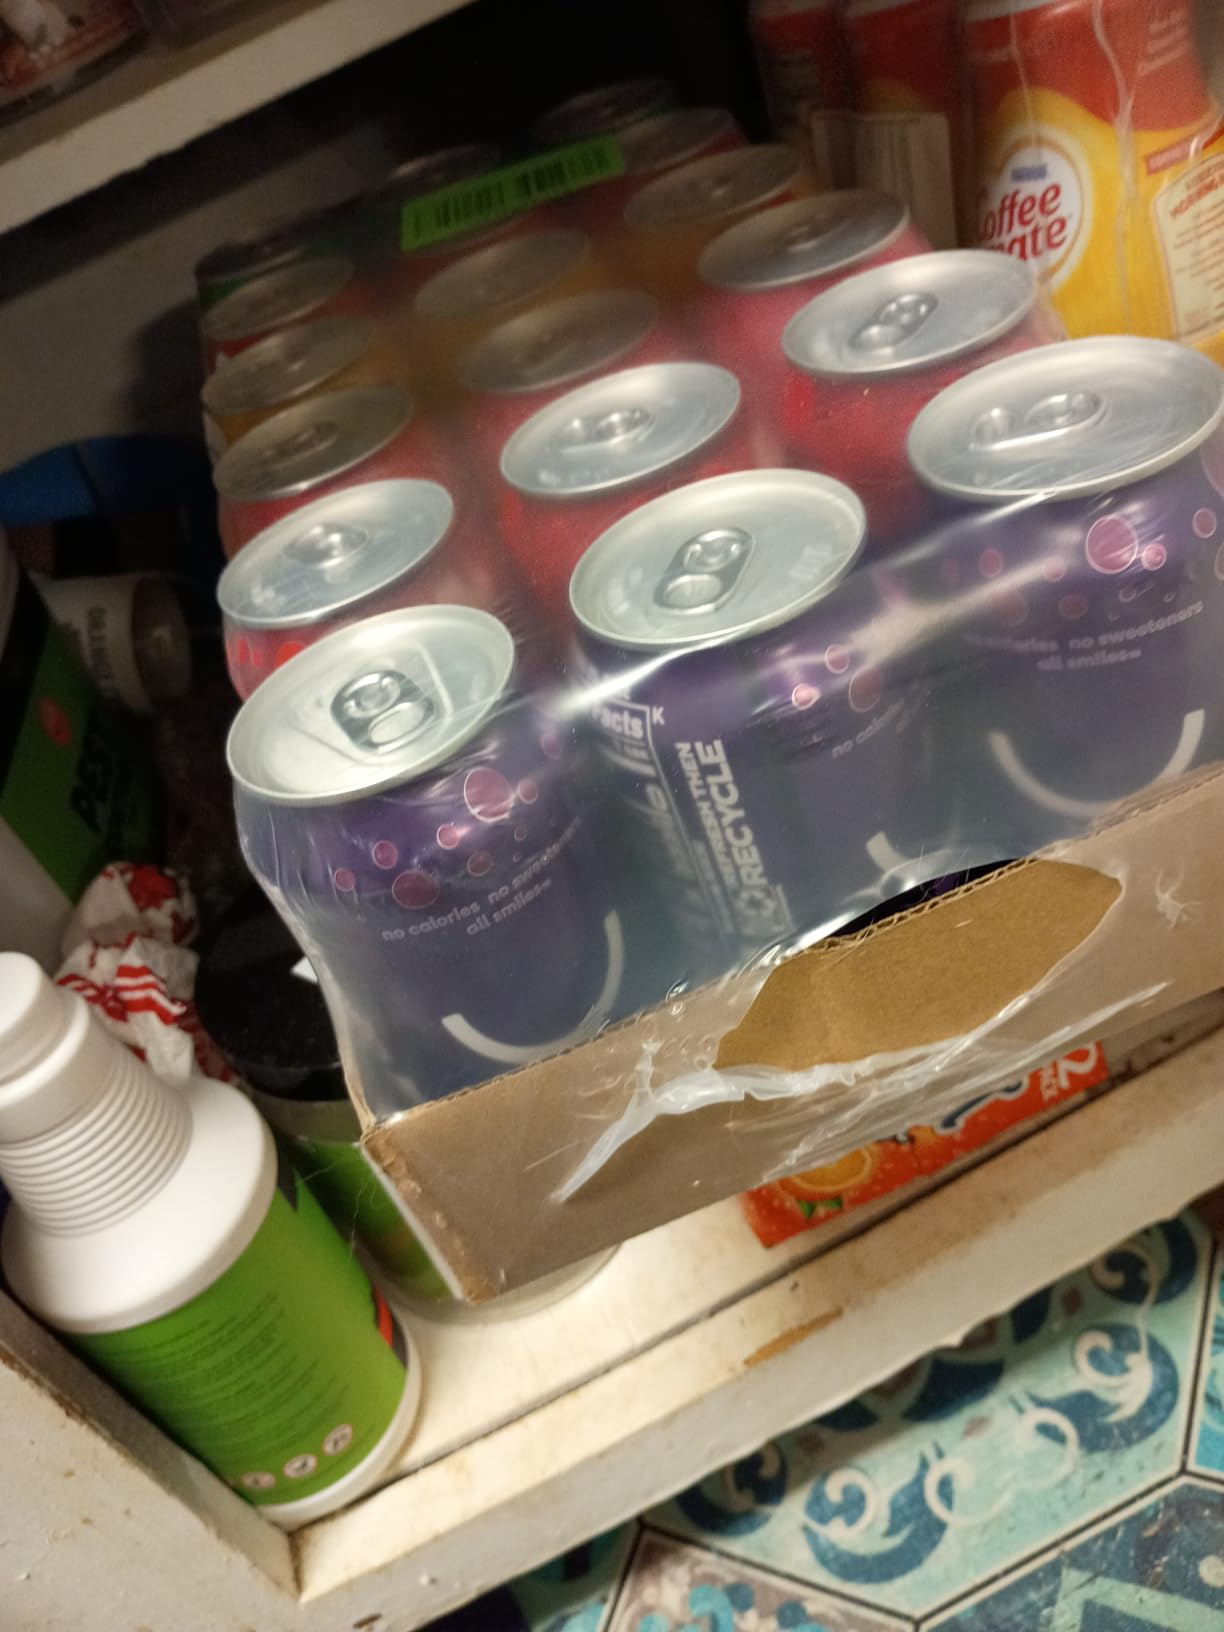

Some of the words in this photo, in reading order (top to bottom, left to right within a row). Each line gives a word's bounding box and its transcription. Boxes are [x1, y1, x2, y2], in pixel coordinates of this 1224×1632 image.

[980, 182, 1062, 241] offee
[985, 216, 1067, 262] ate
[1069, 637, 1094, 650] no
[674, 741, 708, 799] THEN
[831, 740, 853, 759] no
[694, 739, 770, 890] RECYCLE
[382, 925, 405, 942] no
[407, 901, 481, 934] calories
[487, 884, 510, 904] no
[465, 913, 492, 936] all
[492, 884, 543, 923] smiles
